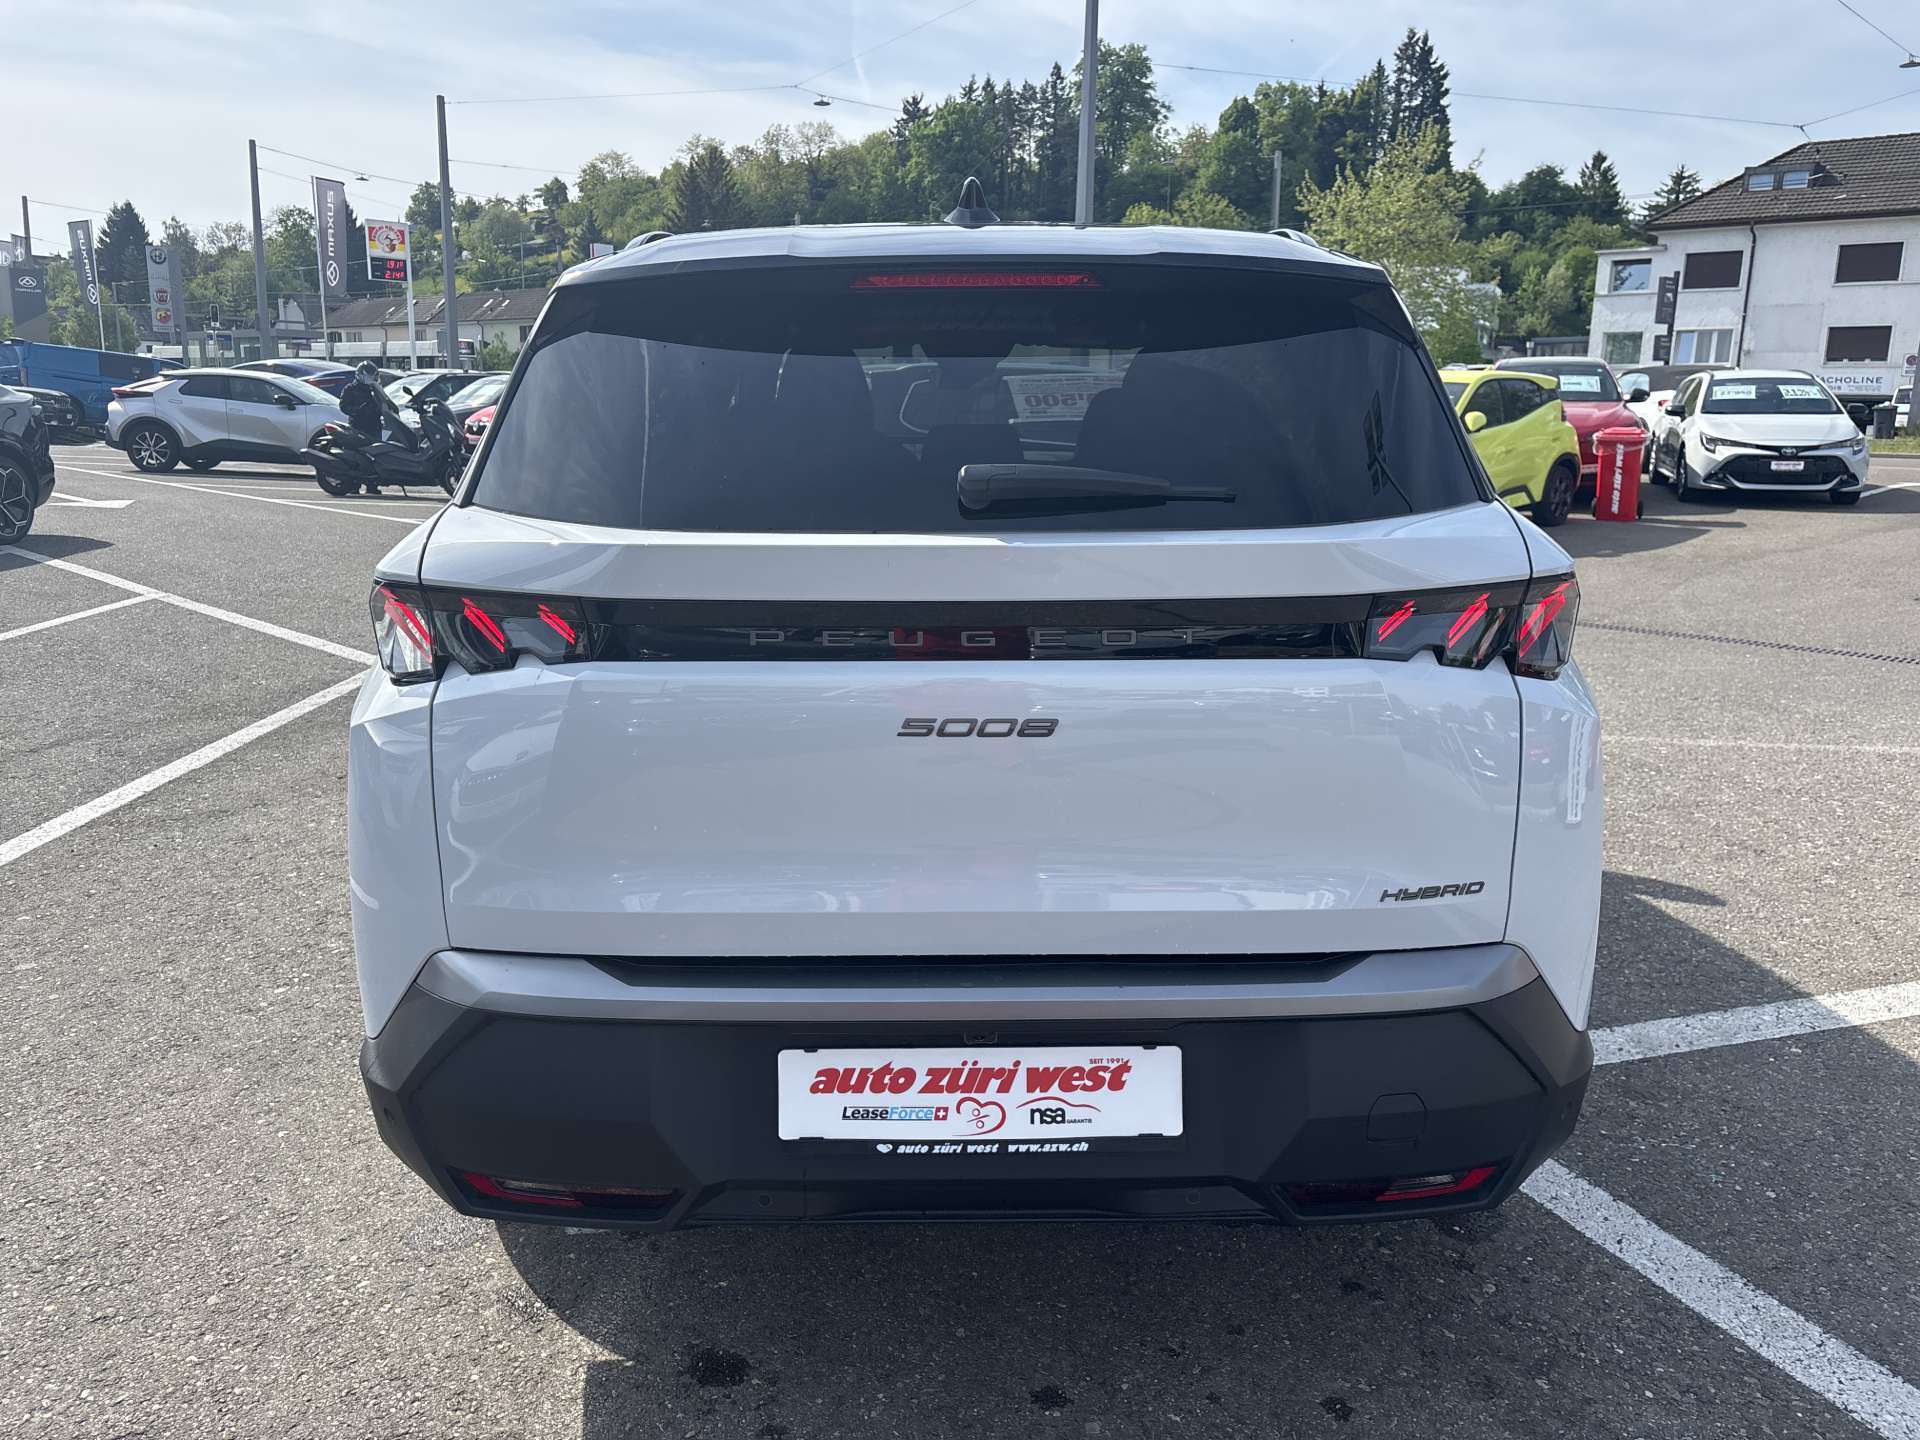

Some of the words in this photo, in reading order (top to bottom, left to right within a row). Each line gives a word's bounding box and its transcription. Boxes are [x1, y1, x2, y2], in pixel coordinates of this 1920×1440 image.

[749, 629, 1206, 648] PEUGEOT
[897, 718, 1059, 738] 5008
[1379, 881, 1486, 903] HYBRID
[810, 1060, 917, 1094] auto
[917, 1059, 1021, 1094] züri
[1026, 1058, 1134, 1093] west
[842, 1106, 934, 1120] LeaseForce
[1030, 1107, 1066, 1125] nsa
[896, 1143, 930, 1154] auto
[932, 1142, 964, 1154] züri
[967, 1143, 1000, 1153] west
